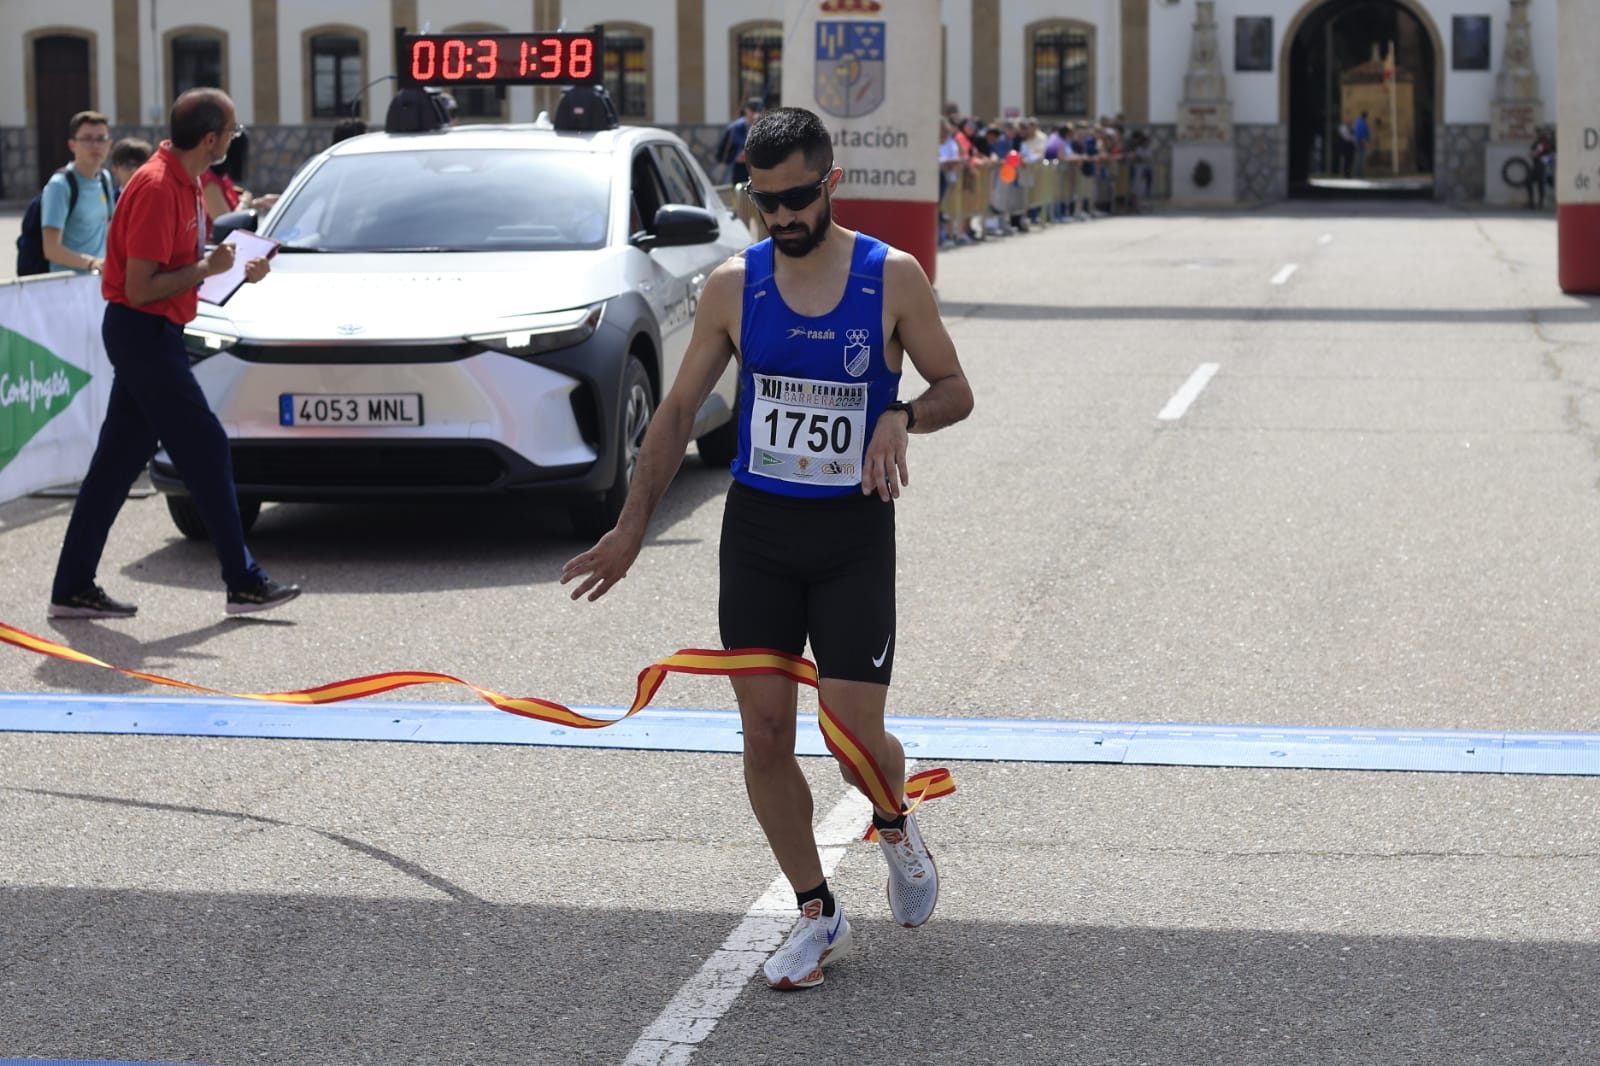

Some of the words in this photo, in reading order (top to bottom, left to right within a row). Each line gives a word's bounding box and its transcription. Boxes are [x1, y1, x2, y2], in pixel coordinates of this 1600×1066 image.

[832, 126, 908, 148] utación
[839, 168, 917, 187] amanca
[761, 378, 782, 399] XII
[785, 382, 803, 393] SAN
[812, 384, 862, 397] FERNANDO
[299, 399, 358, 421] 4053
[368, 399, 413, 421] MNL
[784, 392, 836, 407] CARRERA
[835, 397, 862, 407] 2024
[765, 408, 852, 454] 1750
